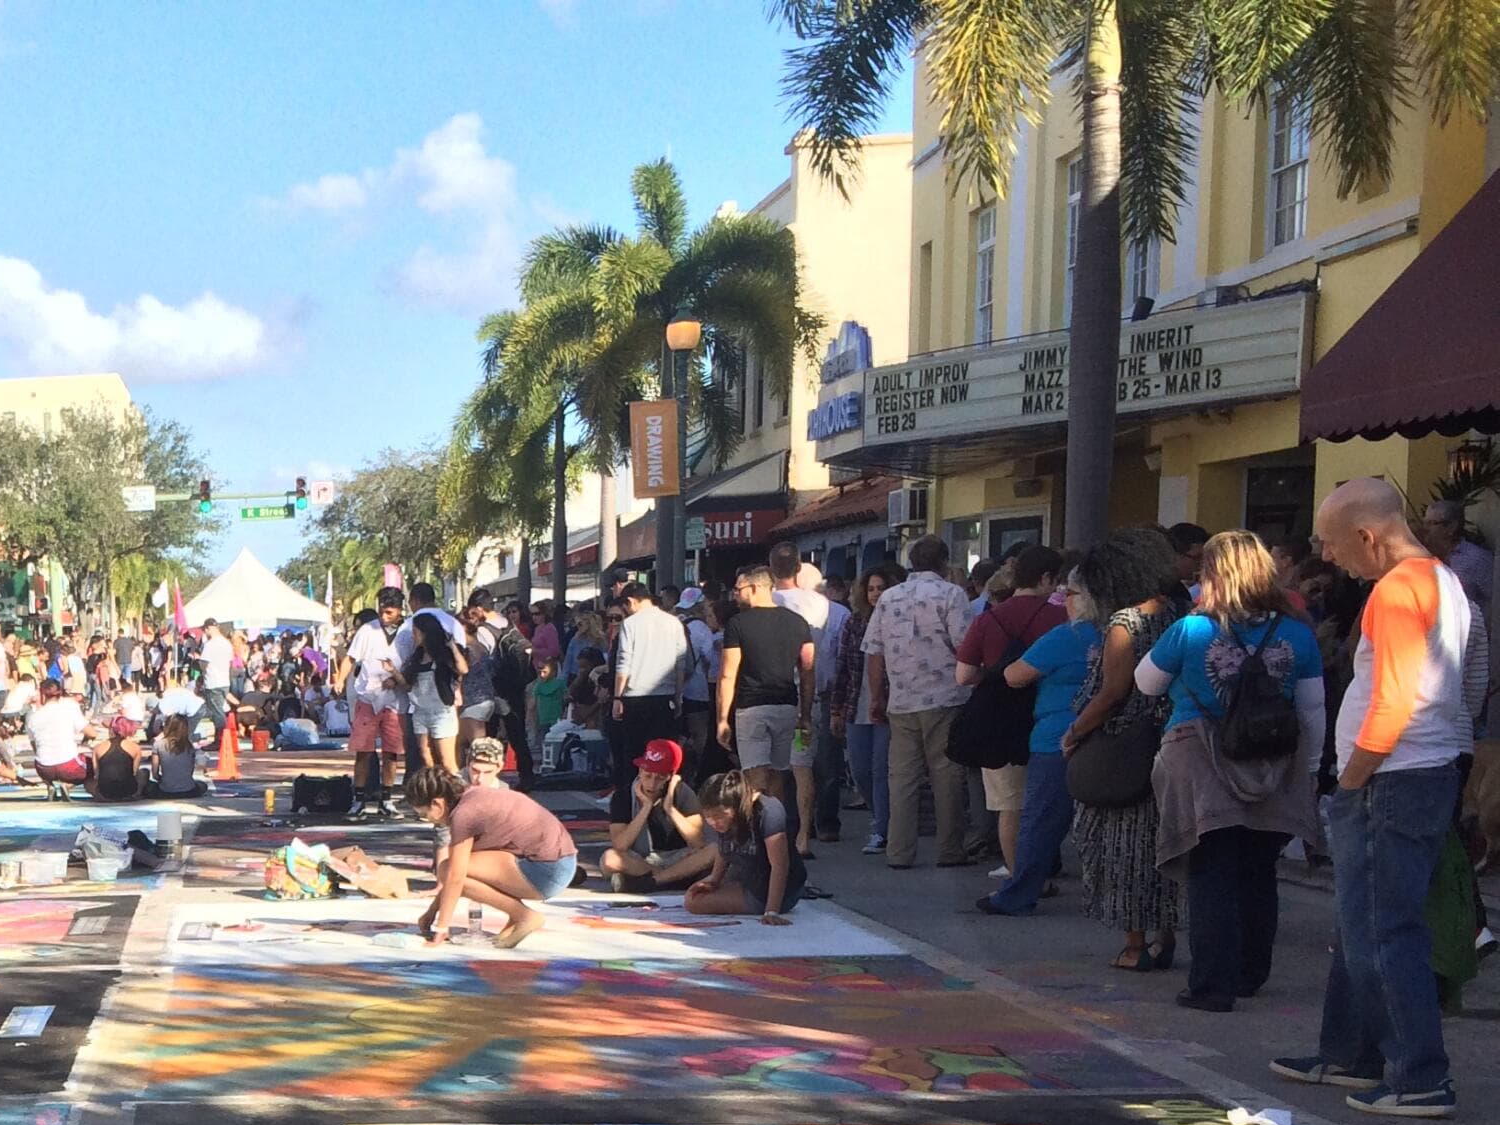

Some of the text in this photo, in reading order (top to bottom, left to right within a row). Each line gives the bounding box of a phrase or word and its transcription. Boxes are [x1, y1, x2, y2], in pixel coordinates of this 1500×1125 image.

[1130, 325, 1194, 355] INHERIT
[1019, 346, 1068, 372] JIMMY
[1118, 347, 1203, 379] THE WIND
[873, 362, 971, 396] ADULT IMPROV
[1024, 369, 1064, 393] MAZZ
[1133, 378, 1151, 400] 25
[1165, 371, 1200, 396] MAR
[1206, 368, 1222, 390] 13
[875, 383, 970, 415] REGISTER NOW
[1022, 393, 1053, 415] MAR
[878, 412, 917, 435] FEB 29
[645, 415, 664, 487] DRAWING
